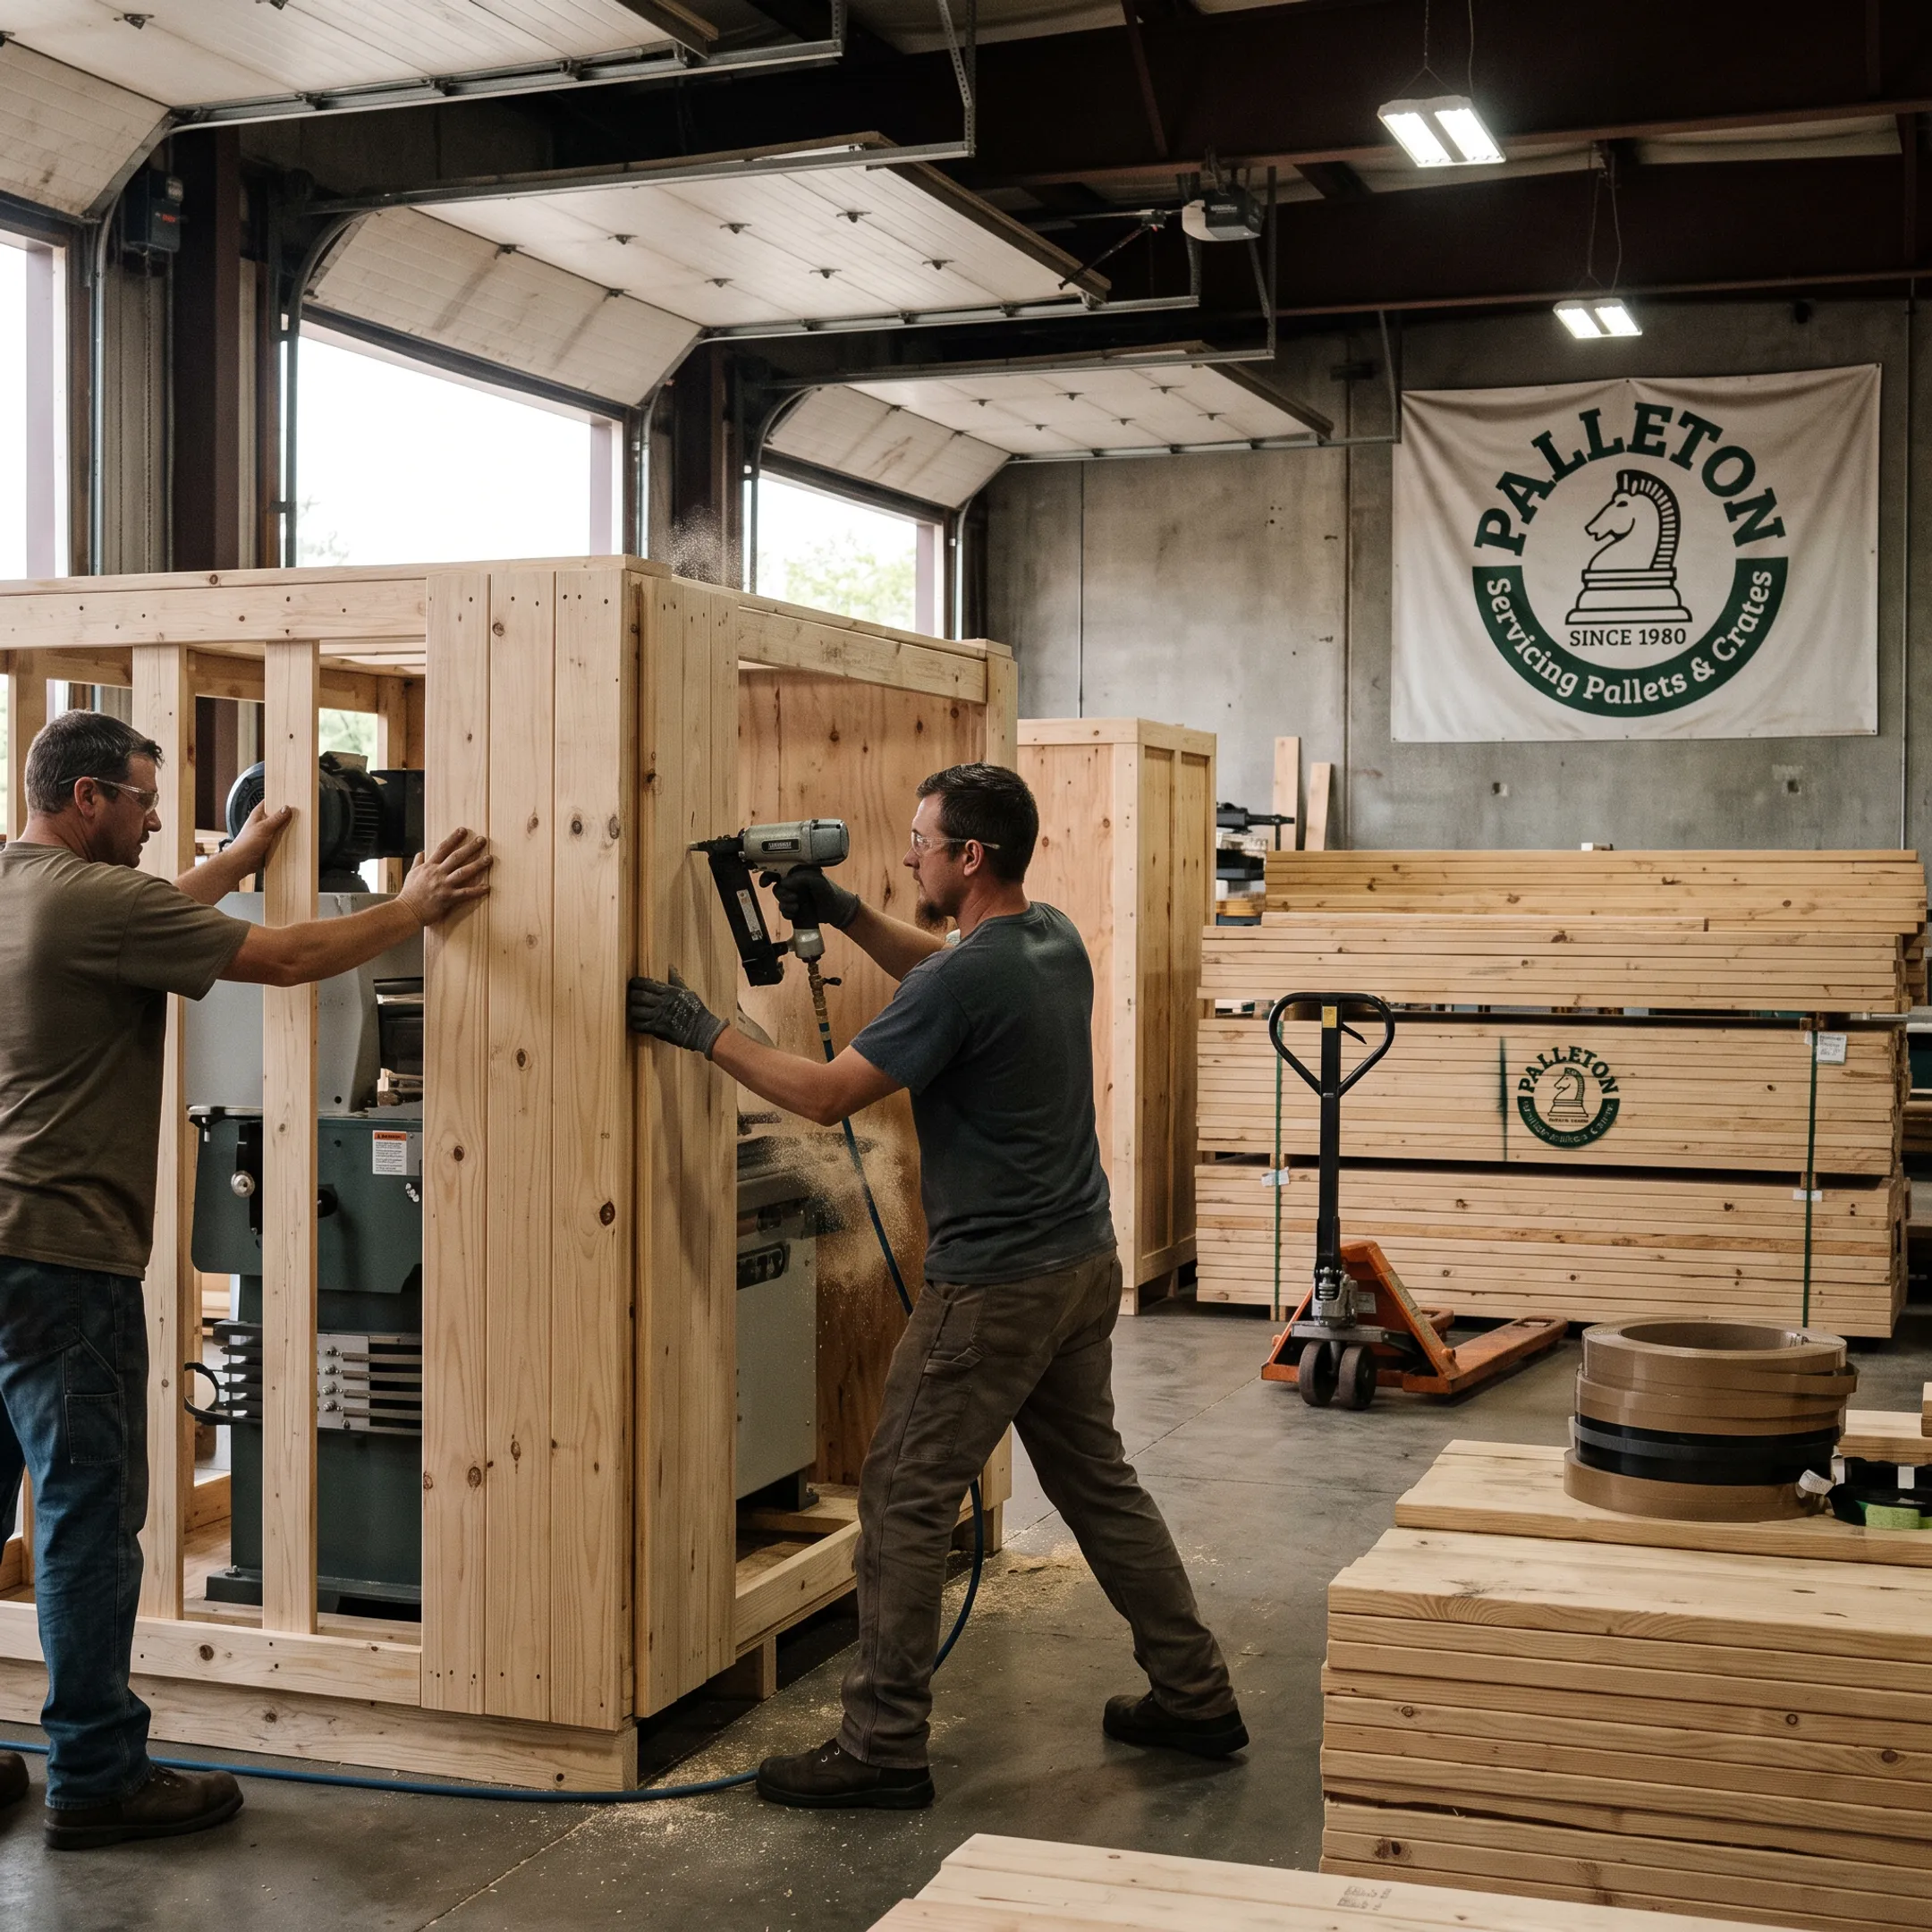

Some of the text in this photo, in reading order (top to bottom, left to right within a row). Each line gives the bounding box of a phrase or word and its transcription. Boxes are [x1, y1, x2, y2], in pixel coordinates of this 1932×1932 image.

[1474, 402, 1786, 557] PALLETON
[1487, 570, 1772, 705] Servicing Pallets & Crates
[1569, 628, 1687, 647] SINCE 1980
[1519, 1046, 1619, 1093] PALLETON
